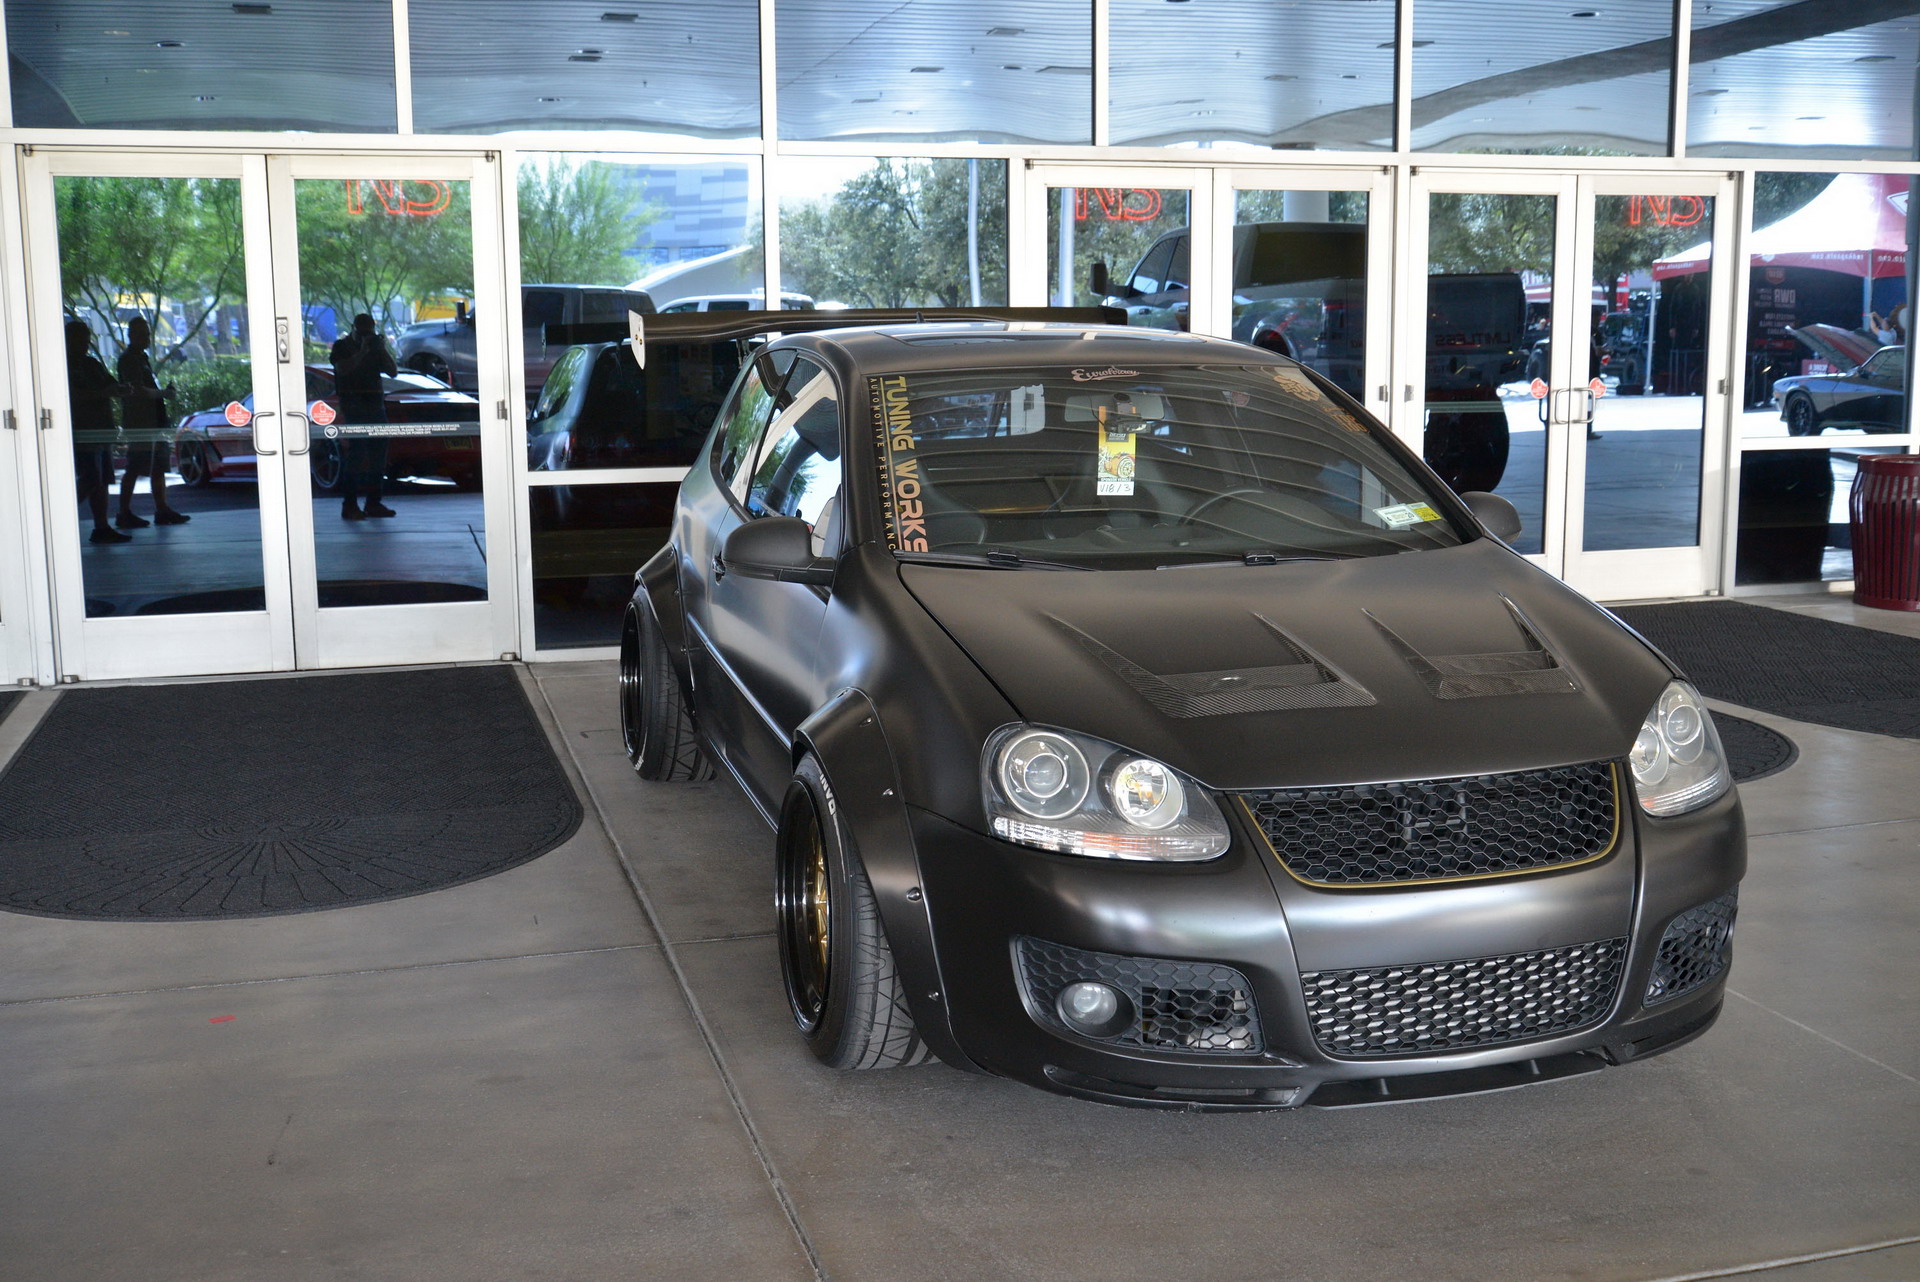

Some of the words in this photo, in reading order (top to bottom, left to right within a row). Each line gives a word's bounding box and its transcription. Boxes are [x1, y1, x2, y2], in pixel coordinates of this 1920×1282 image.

[885, 375, 915, 451] TUNING
[870, 378, 885, 448] AUTOMOTIVE
[878, 456, 896, 550] PERFORMANC
[895, 458, 929, 552] WORKS
